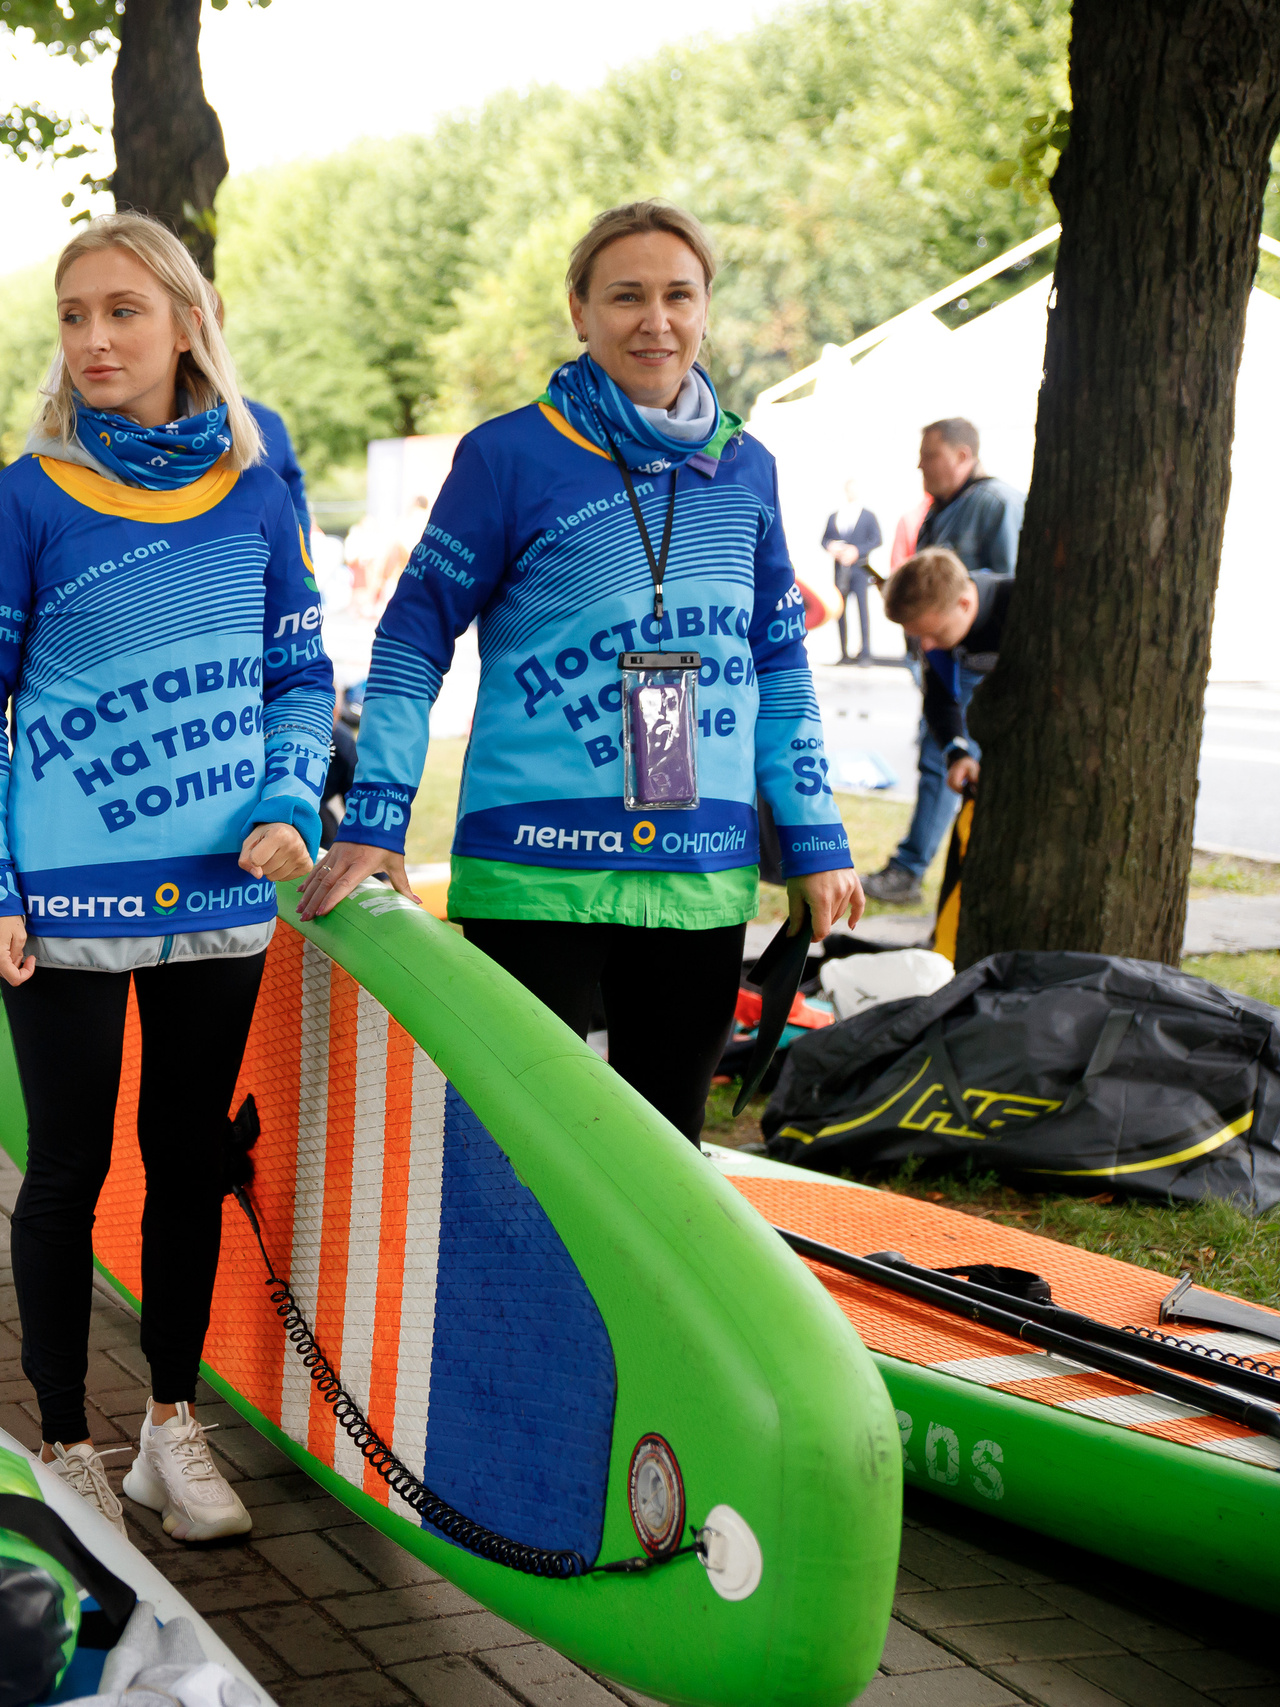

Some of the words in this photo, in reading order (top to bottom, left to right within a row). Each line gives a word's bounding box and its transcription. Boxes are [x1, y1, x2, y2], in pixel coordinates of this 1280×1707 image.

[513, 605, 750, 719] Доставка
[26, 656, 262, 782] Доставка
[73, 739, 151, 797] на
[98, 758, 256, 834] волне
[342, 797, 405, 831] SUP
[513, 824, 624, 853] лента
[661, 825, 747, 853] онлайн
[27, 894, 146, 918] лента
